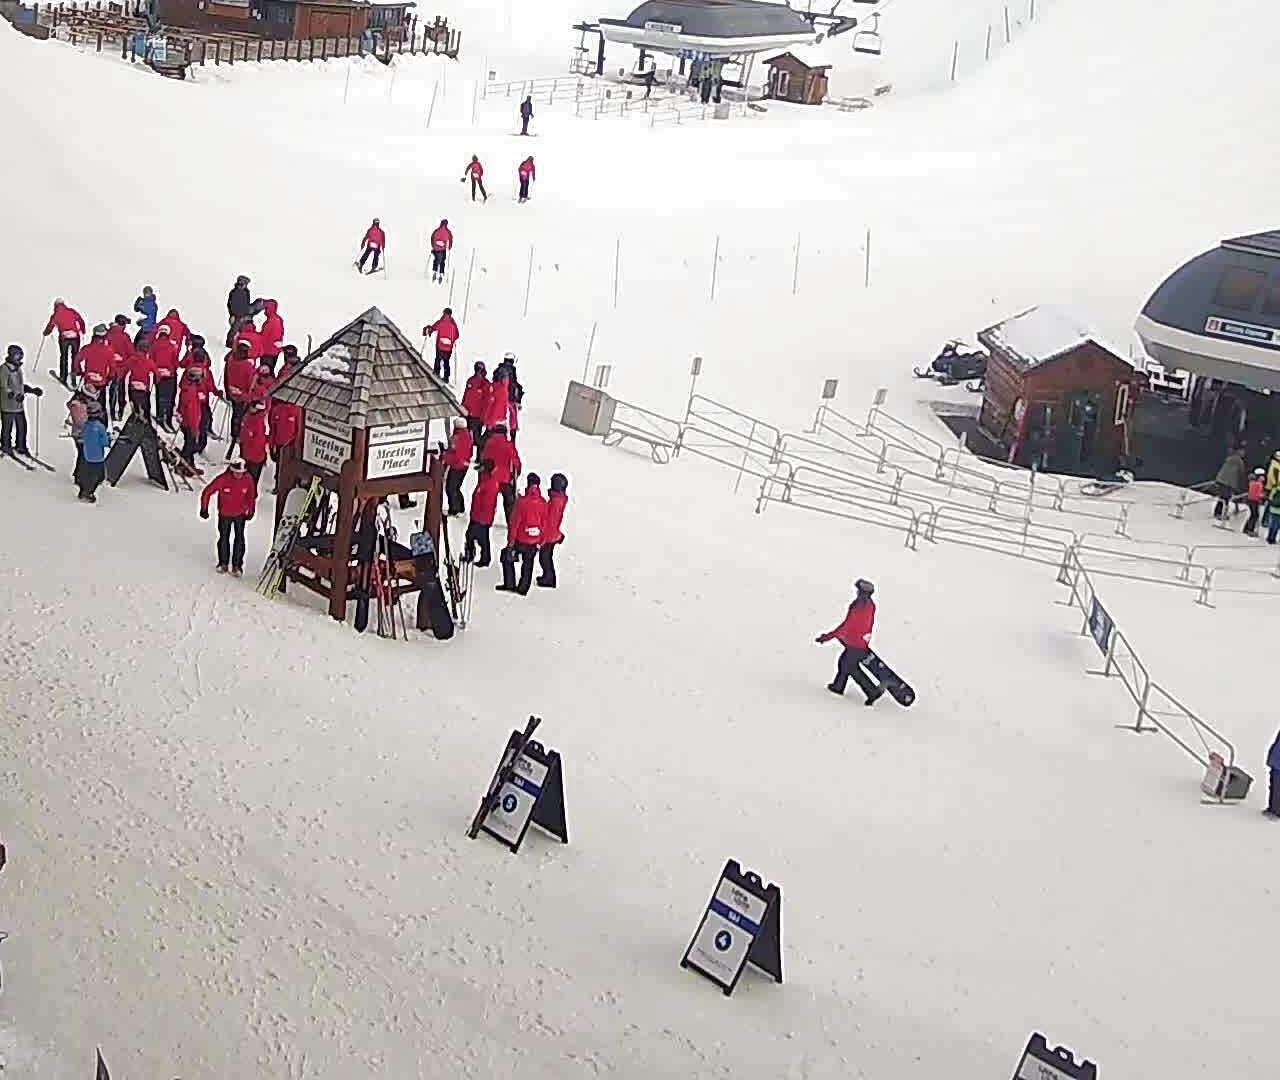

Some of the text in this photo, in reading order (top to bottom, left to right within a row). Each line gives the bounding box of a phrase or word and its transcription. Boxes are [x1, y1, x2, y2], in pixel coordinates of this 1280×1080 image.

[314, 447, 340, 464] Place
[376, 446, 417, 460] Meeting
[381, 458, 411, 471] Place
